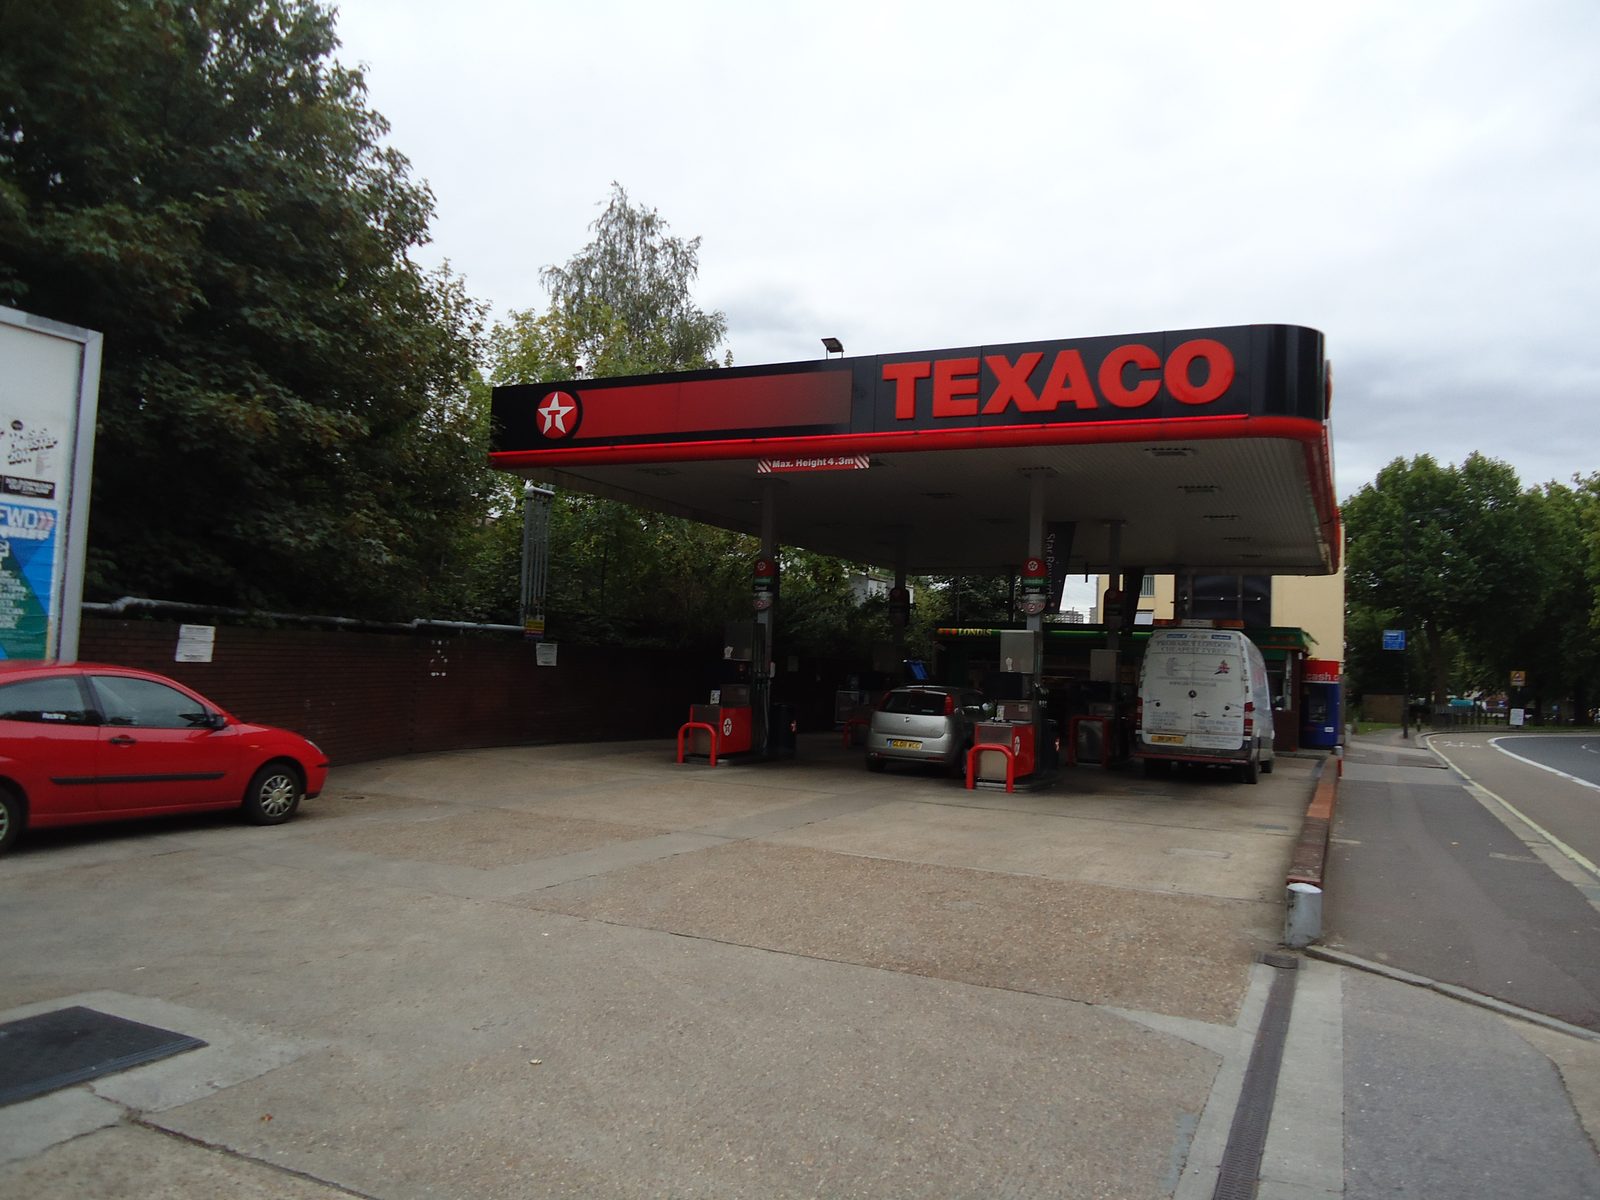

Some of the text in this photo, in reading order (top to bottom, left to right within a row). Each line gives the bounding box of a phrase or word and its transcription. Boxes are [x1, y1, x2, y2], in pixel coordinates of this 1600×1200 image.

[882, 338, 1236, 421] TEXACO
[772, 456, 855, 469] Max. Height 4.3m
[959, 628, 992, 637] LONDIS
[1306, 672, 1331, 681] cash
